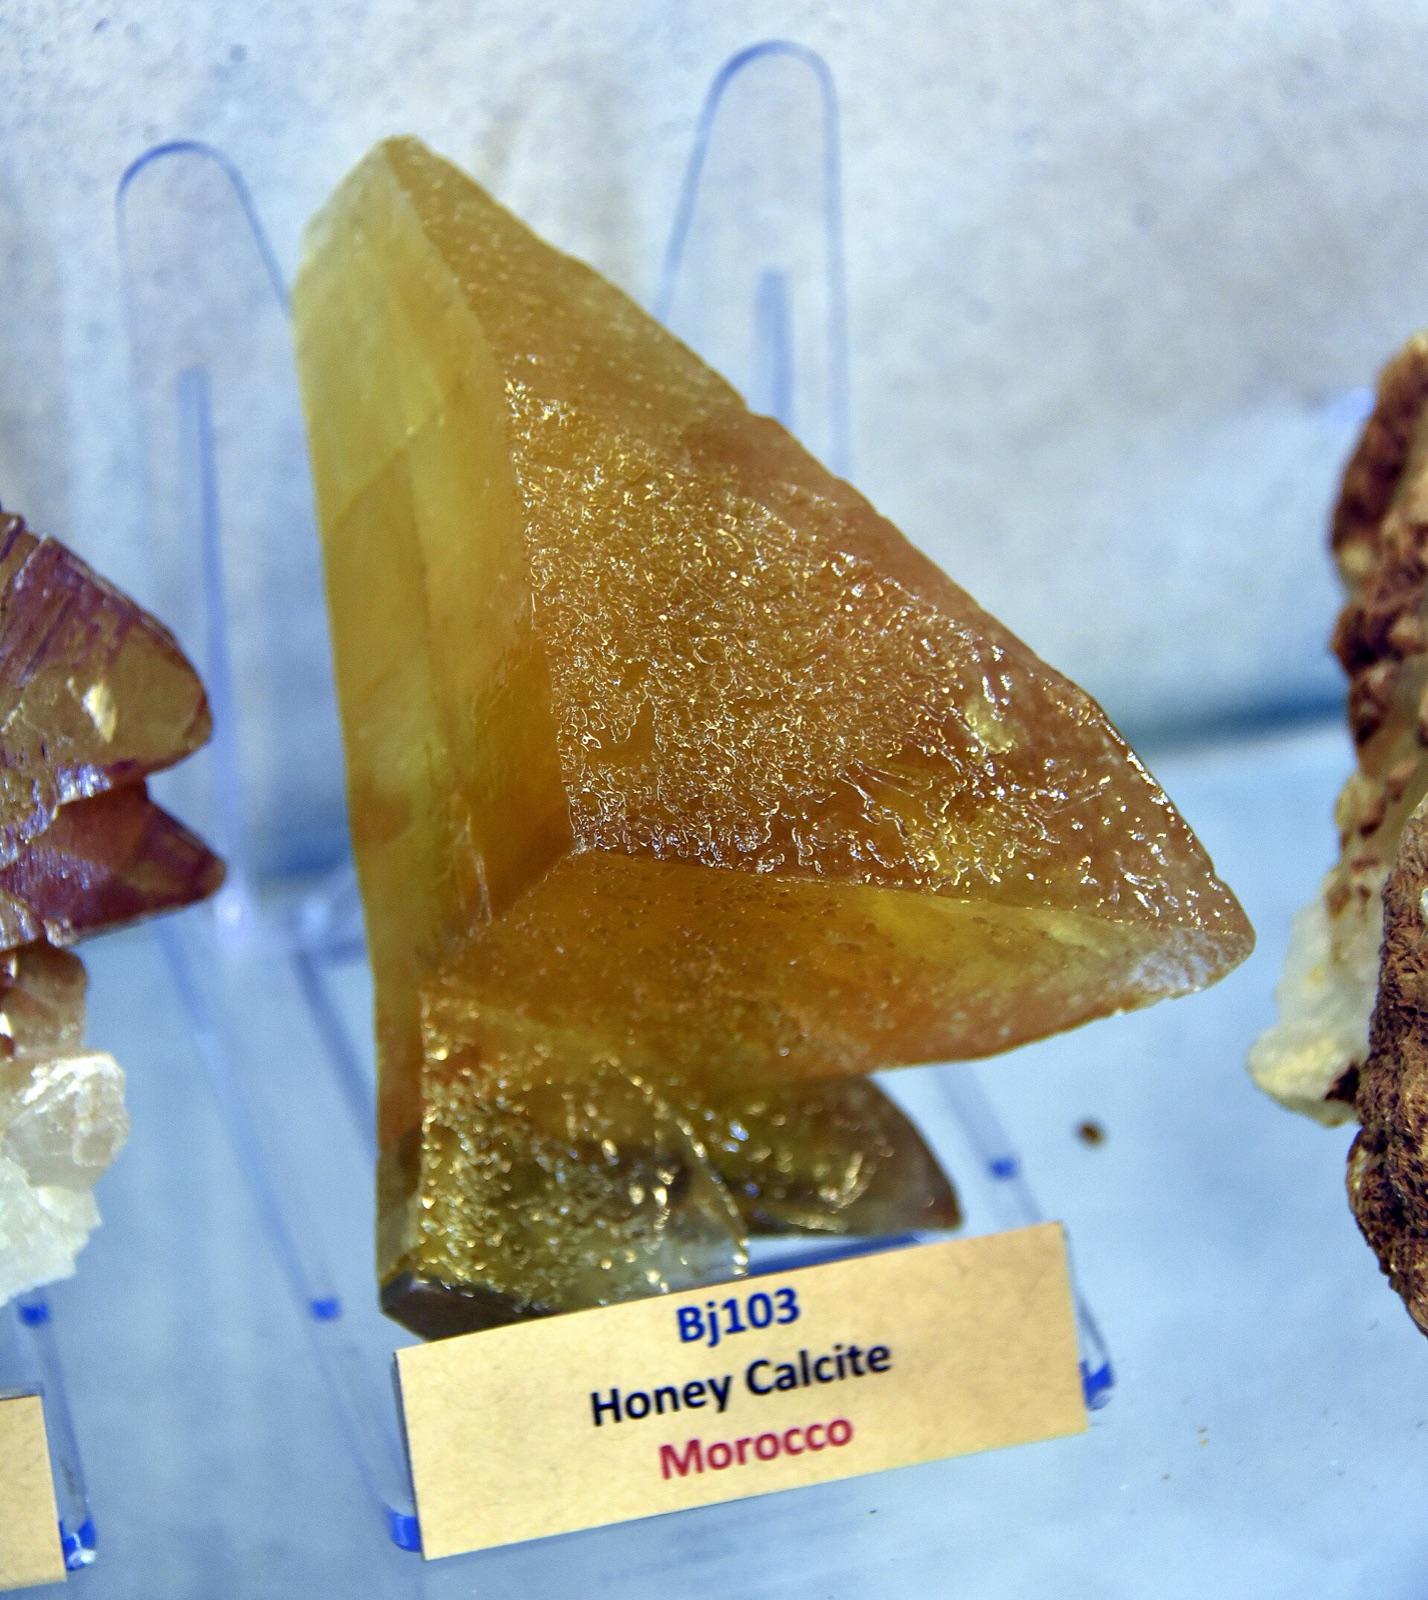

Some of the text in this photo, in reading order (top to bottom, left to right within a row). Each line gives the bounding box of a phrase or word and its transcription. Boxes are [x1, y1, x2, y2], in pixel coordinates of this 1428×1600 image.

[677, 1287, 800, 1347] Bj103
[590, 1344, 892, 1427] Honey Calcite
[659, 1418, 853, 1480] Morocco
